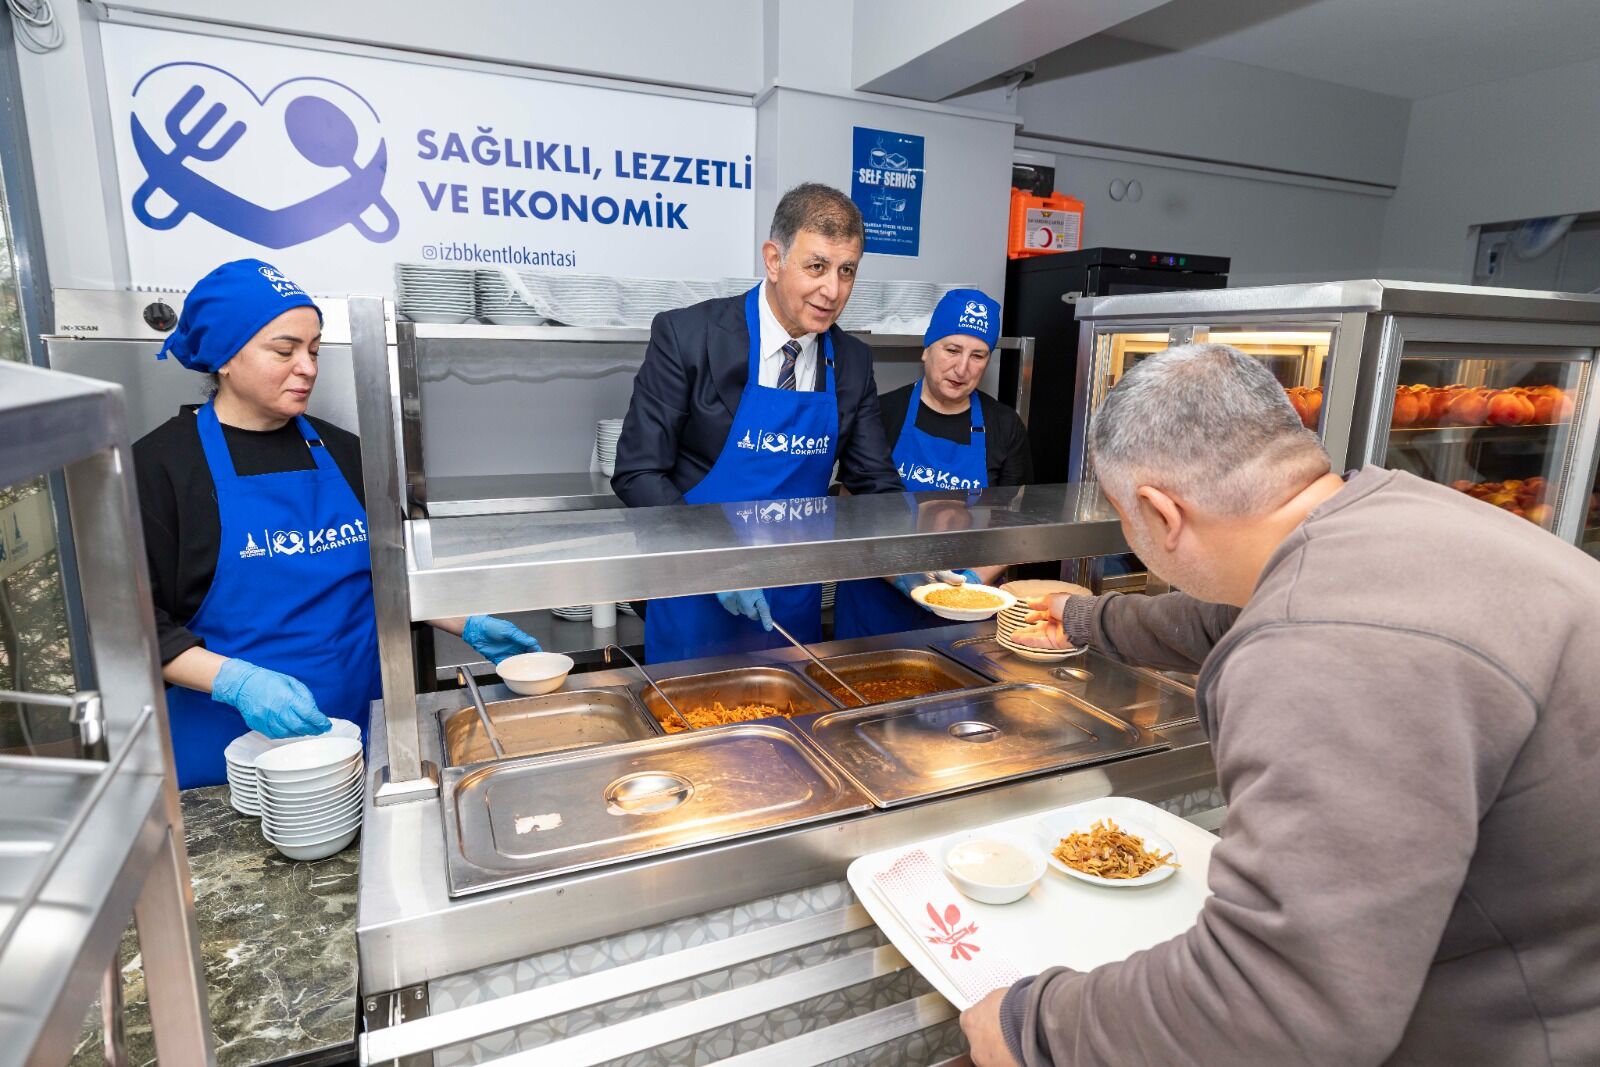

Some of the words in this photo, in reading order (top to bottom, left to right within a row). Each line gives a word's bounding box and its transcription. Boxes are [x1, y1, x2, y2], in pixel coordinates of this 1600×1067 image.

[417, 126, 602, 180] SAĞLIKLI,
[615, 150, 752, 190] LEZZETLİ
[859, 168, 881, 185] SELF
[884, 169, 917, 189] SERVİS
[418, 181, 469, 214] VE
[482, 187, 689, 230] EKONOMİK
[960, 315, 988, 329] Kent
[791, 435, 830, 449] Kent
[937, 471, 980, 489] Kent
[308, 519, 366, 547] Kent
[309, 534, 367, 554] LOKANTASI
